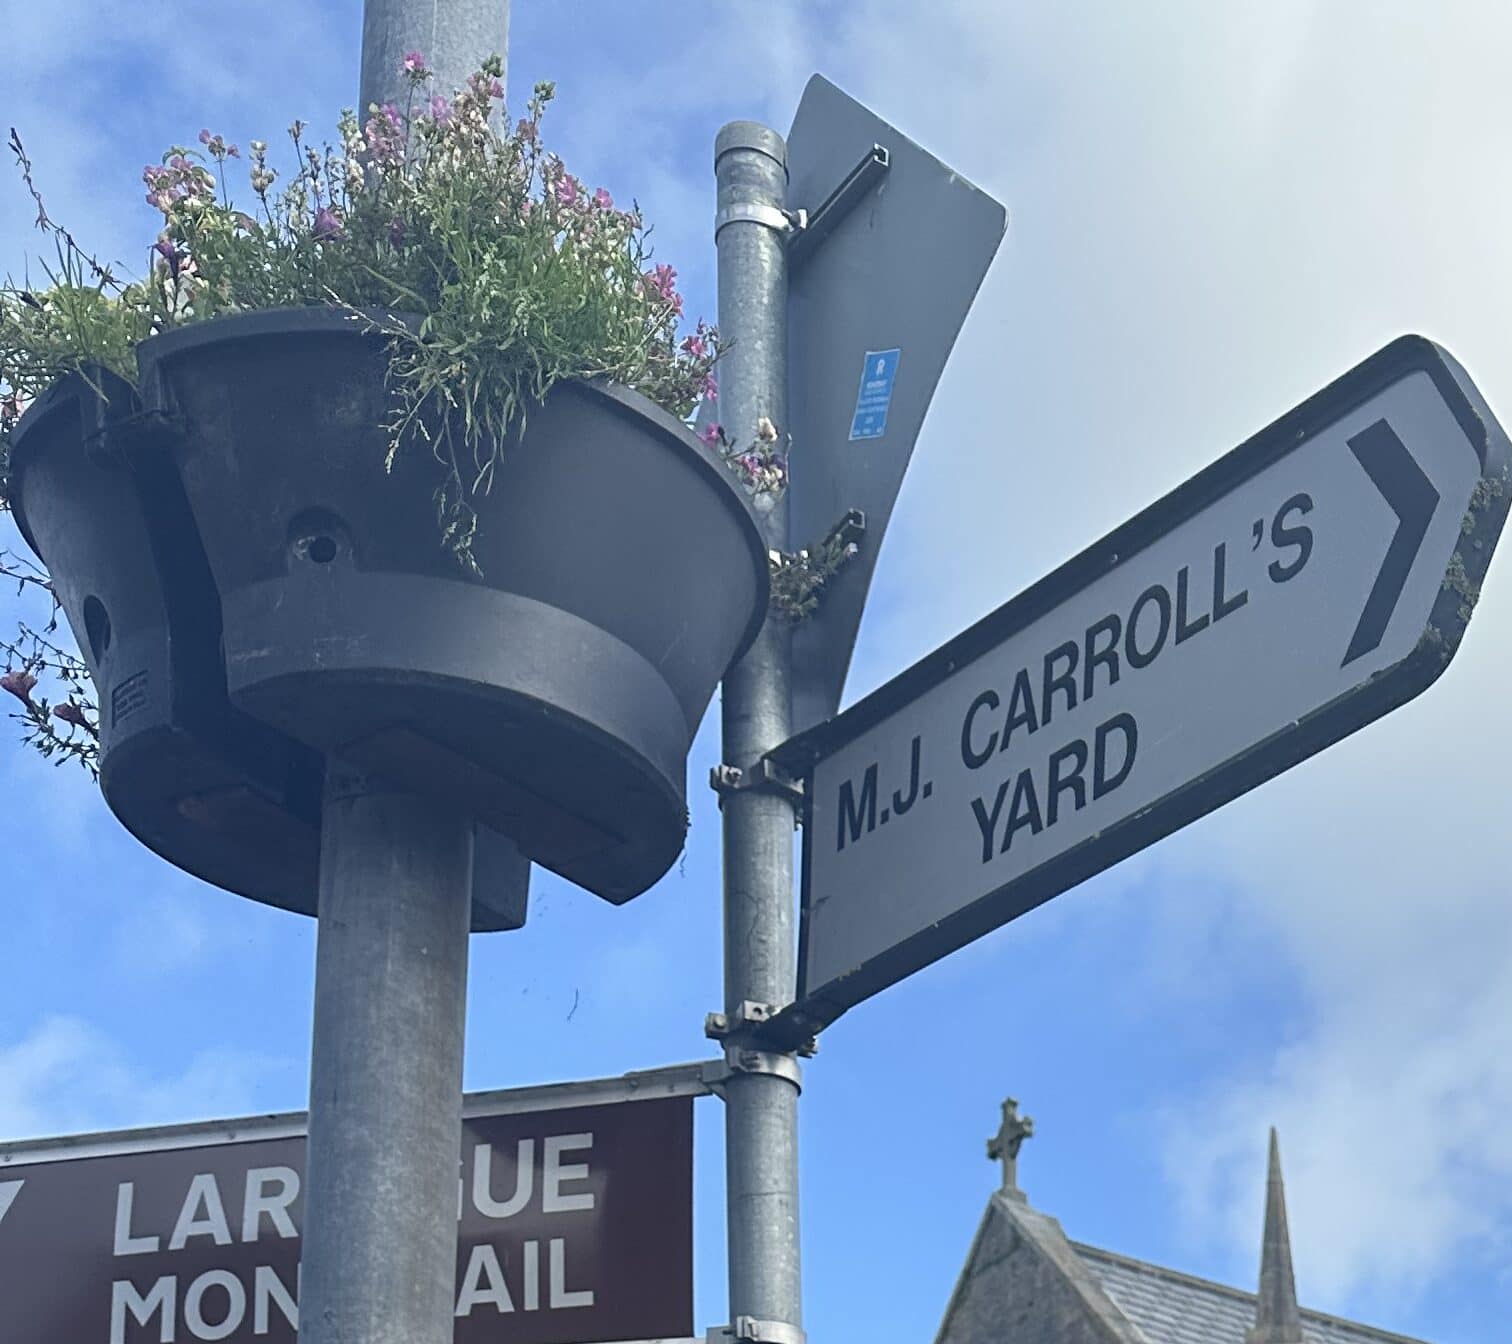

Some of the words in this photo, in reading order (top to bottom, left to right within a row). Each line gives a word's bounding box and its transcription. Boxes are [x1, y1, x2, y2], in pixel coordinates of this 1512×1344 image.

[836, 735, 933, 853] M.J.
[960, 491, 1316, 770] CARROLL'S
[970, 711, 1139, 865] YARD
[113, 1132, 595, 1257] LARUE
